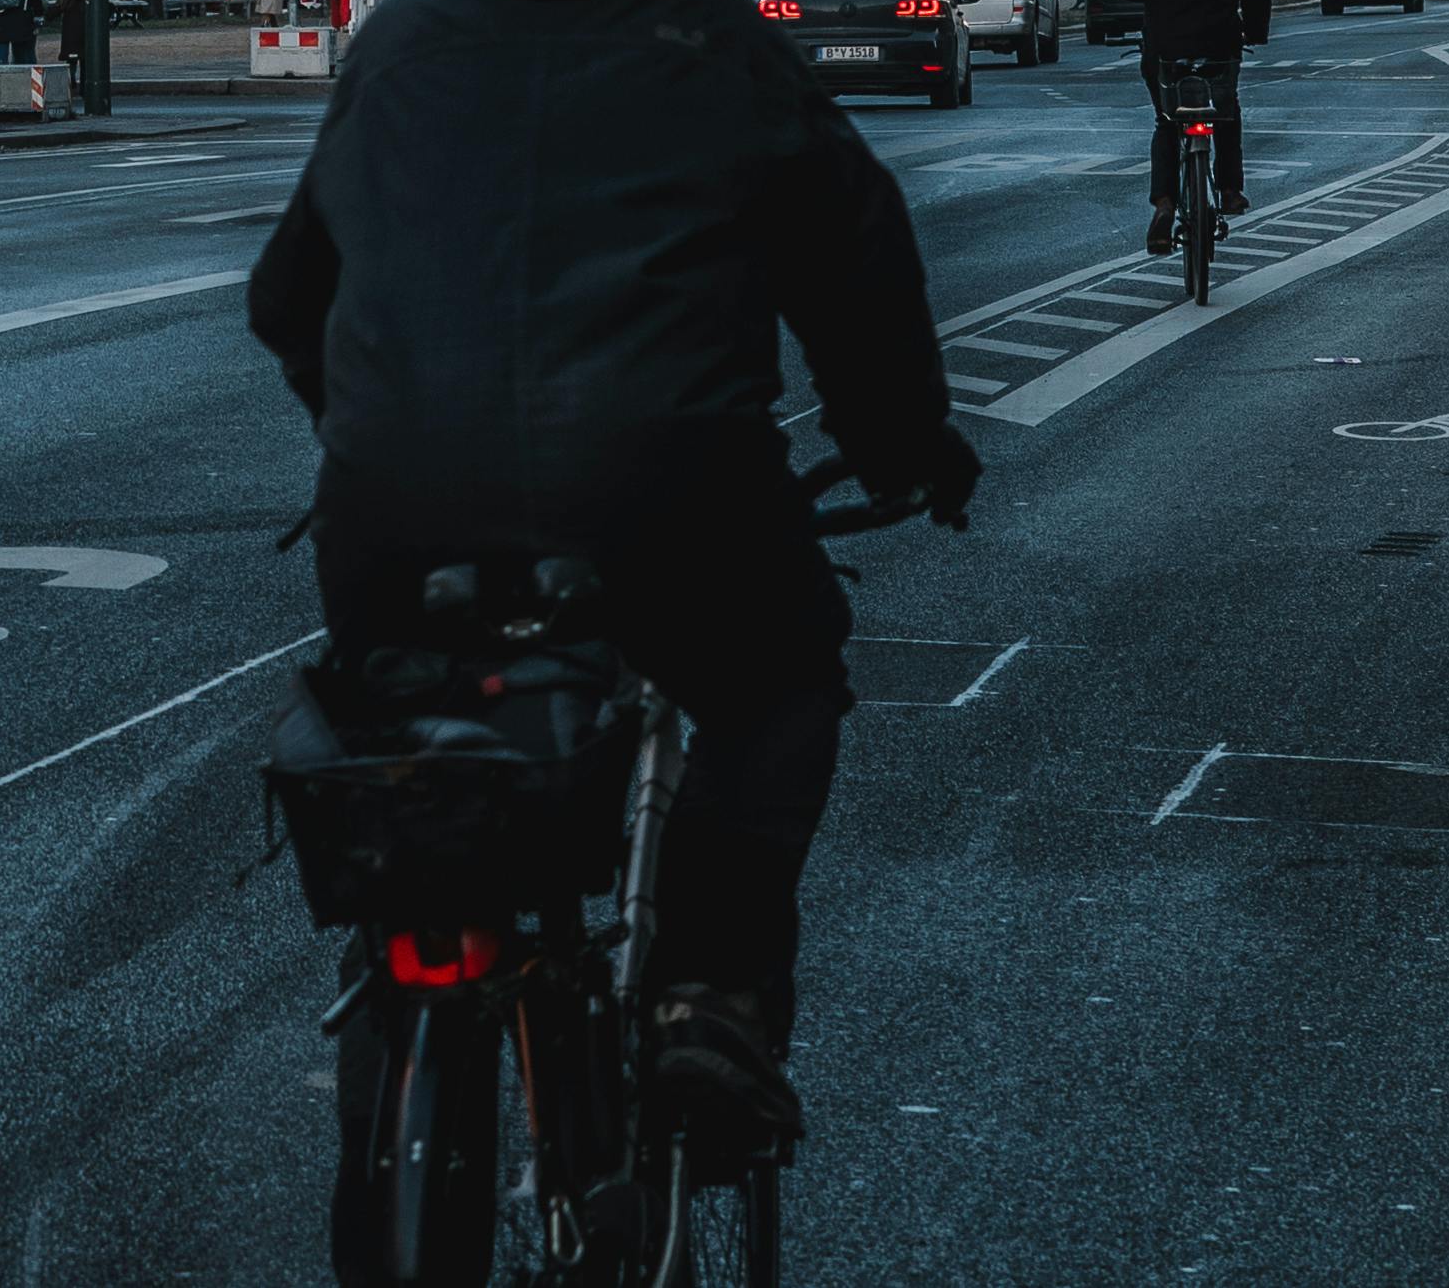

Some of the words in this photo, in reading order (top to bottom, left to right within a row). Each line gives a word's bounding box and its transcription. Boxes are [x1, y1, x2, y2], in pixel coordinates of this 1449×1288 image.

[826, 47, 834, 58] B
[840, 47, 849, 58] Y
[850, 46, 875, 58] 1518
